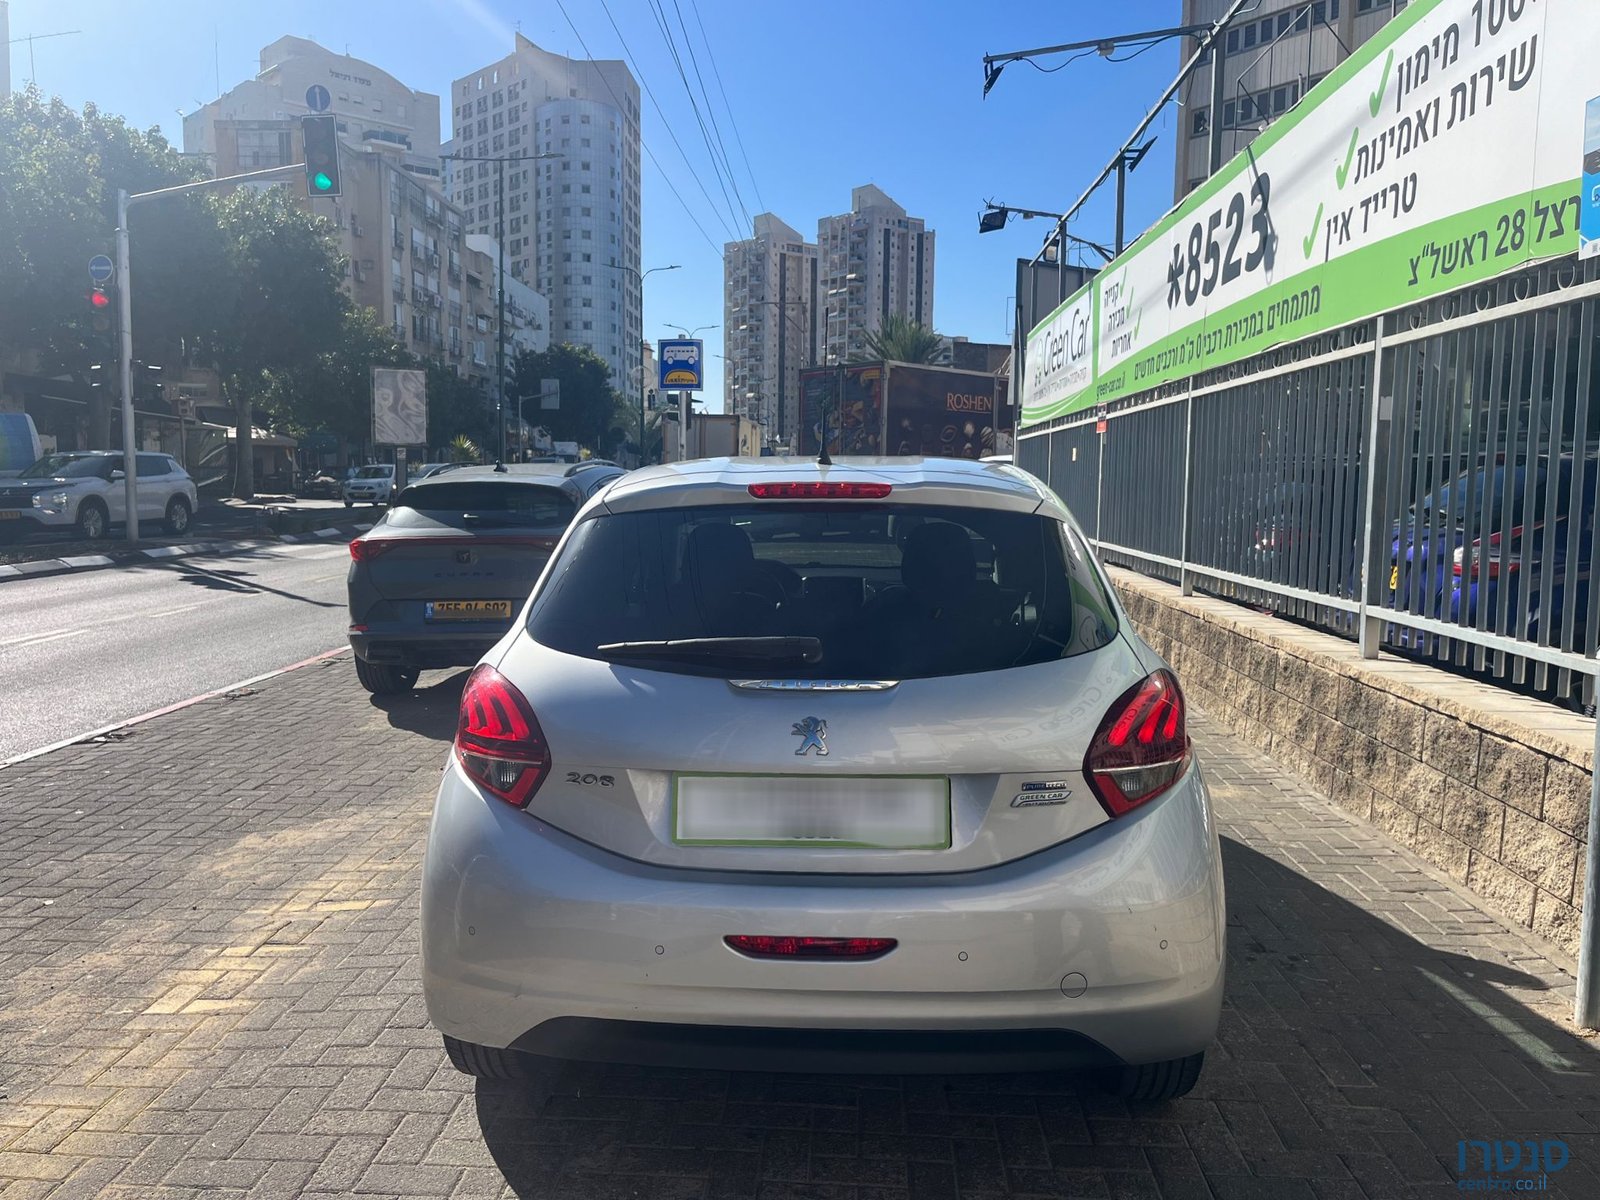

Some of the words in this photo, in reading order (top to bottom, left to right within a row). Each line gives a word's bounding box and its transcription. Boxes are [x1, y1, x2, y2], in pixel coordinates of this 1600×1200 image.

[1396, 22, 1460, 114] מימון
[1447, 34, 1538, 130] שירות
[1354, 96, 1441, 185] ואמינות
[1360, 172, 1417, 234] טרייד
[1324, 206, 1354, 263] אין
[1495, 208, 1526, 257] 28
[1103, 281, 1120, 308] קנייה
[1267, 284, 1321, 331] מתמחים
[1108, 306, 1125, 333] מכירה
[1224, 310, 1264, 348] במכירת
[1043, 330, 1069, 377] Green
[1071, 308, 1090, 362] Car
[1111, 330, 1133, 358] אחריות
[1156, 346, 1179, 372] ורכבים
[1205, 327, 1223, 356] רכבי
[1134, 359, 1155, 381] חדשים
[946, 392, 993, 412] ROSHEN
[565, 771, 615, 787] 208
